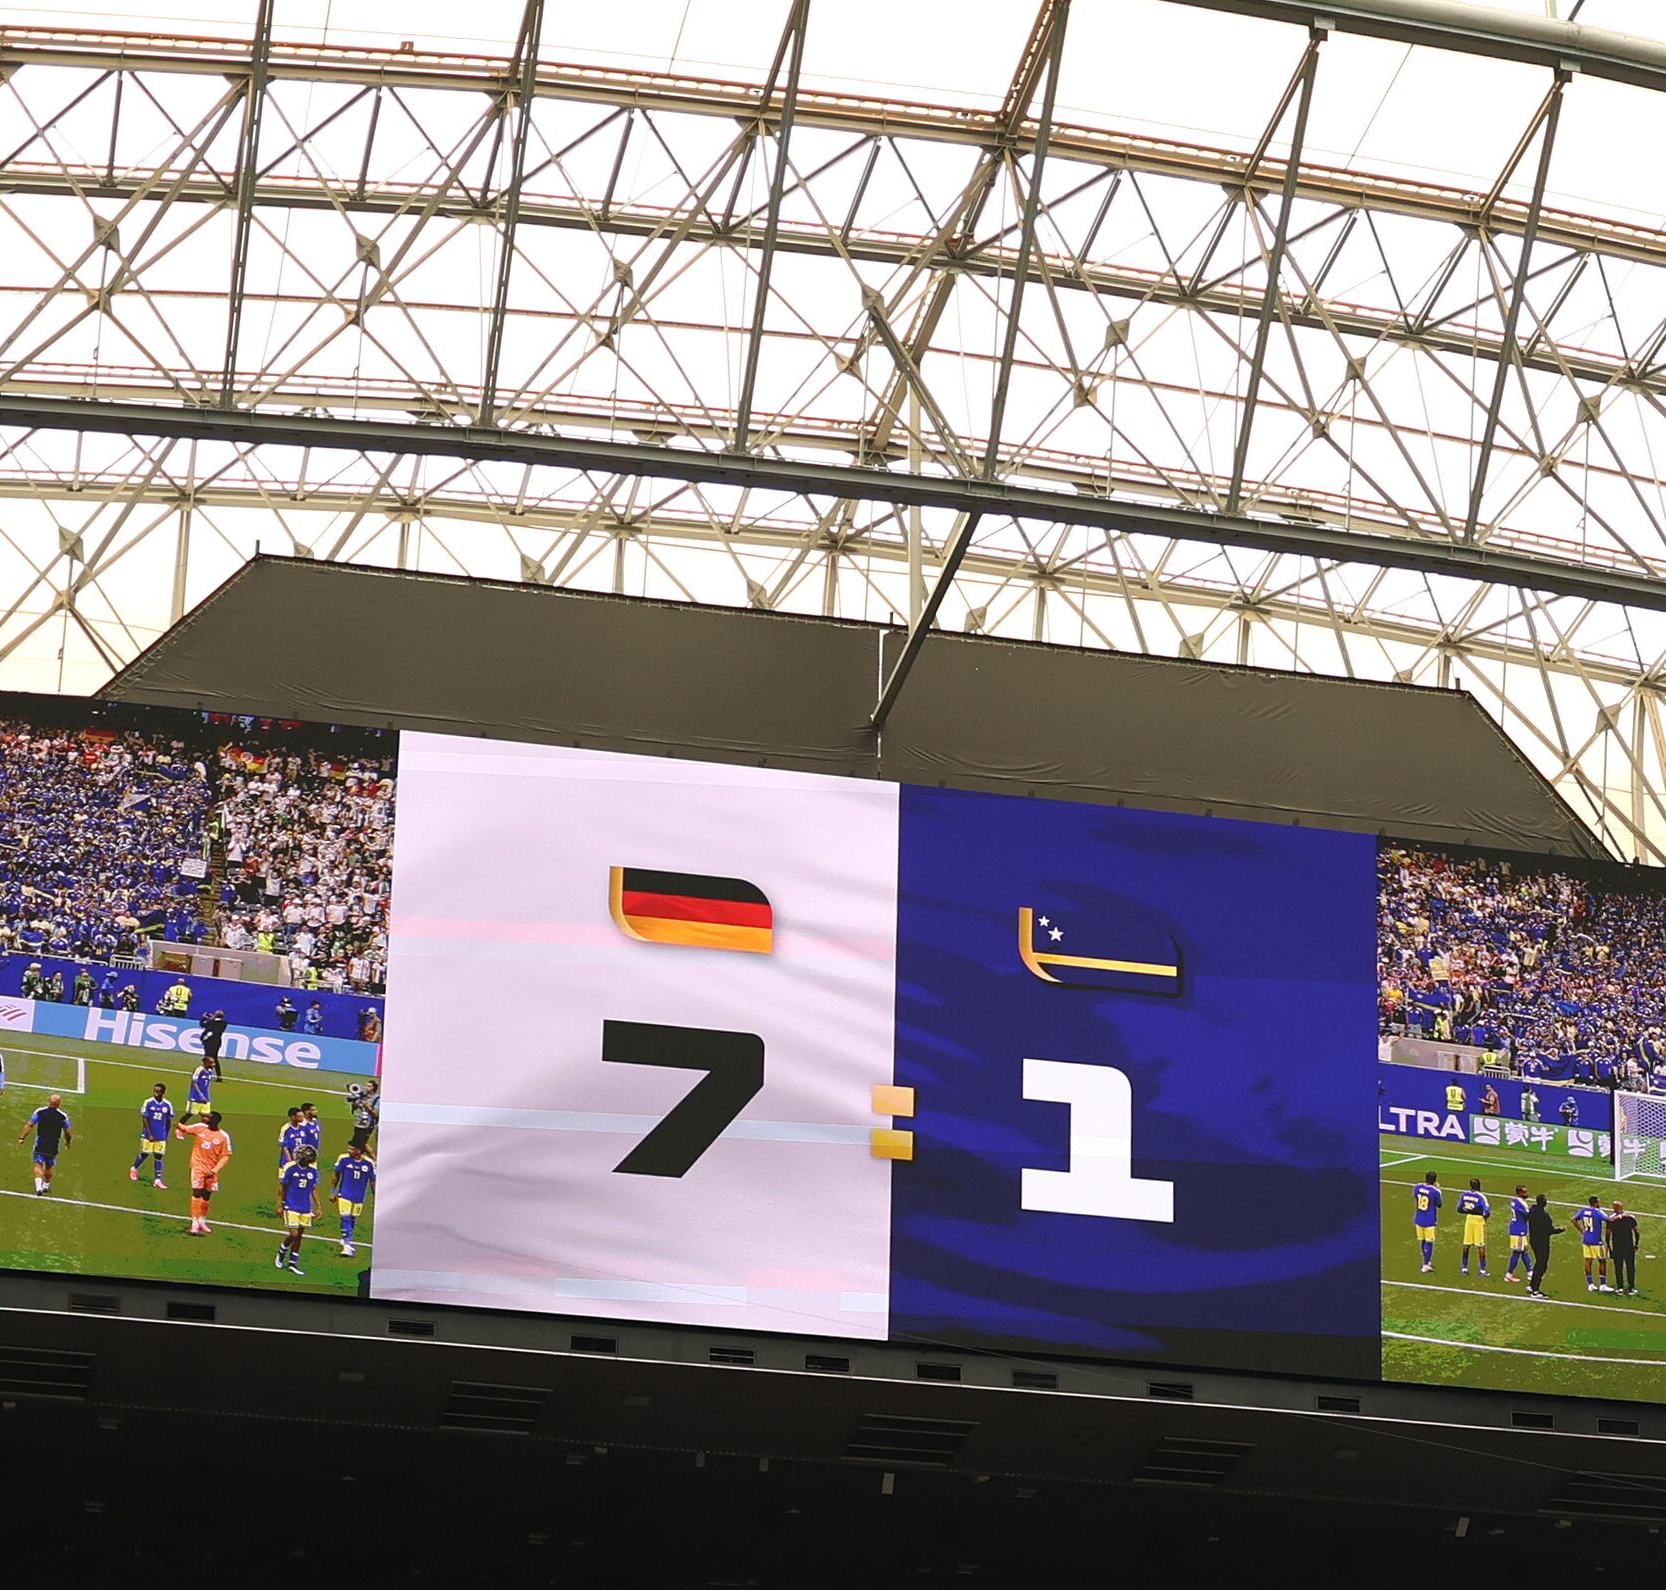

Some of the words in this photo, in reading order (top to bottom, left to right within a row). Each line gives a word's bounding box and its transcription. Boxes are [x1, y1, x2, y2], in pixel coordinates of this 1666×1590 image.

[84, 1007, 321, 1070] Hisense
[601, 1018, 765, 1178] 7
[1020, 1057, 1174, 1223] 1
[1505, 1122, 1555, 1152] 蒙牛
